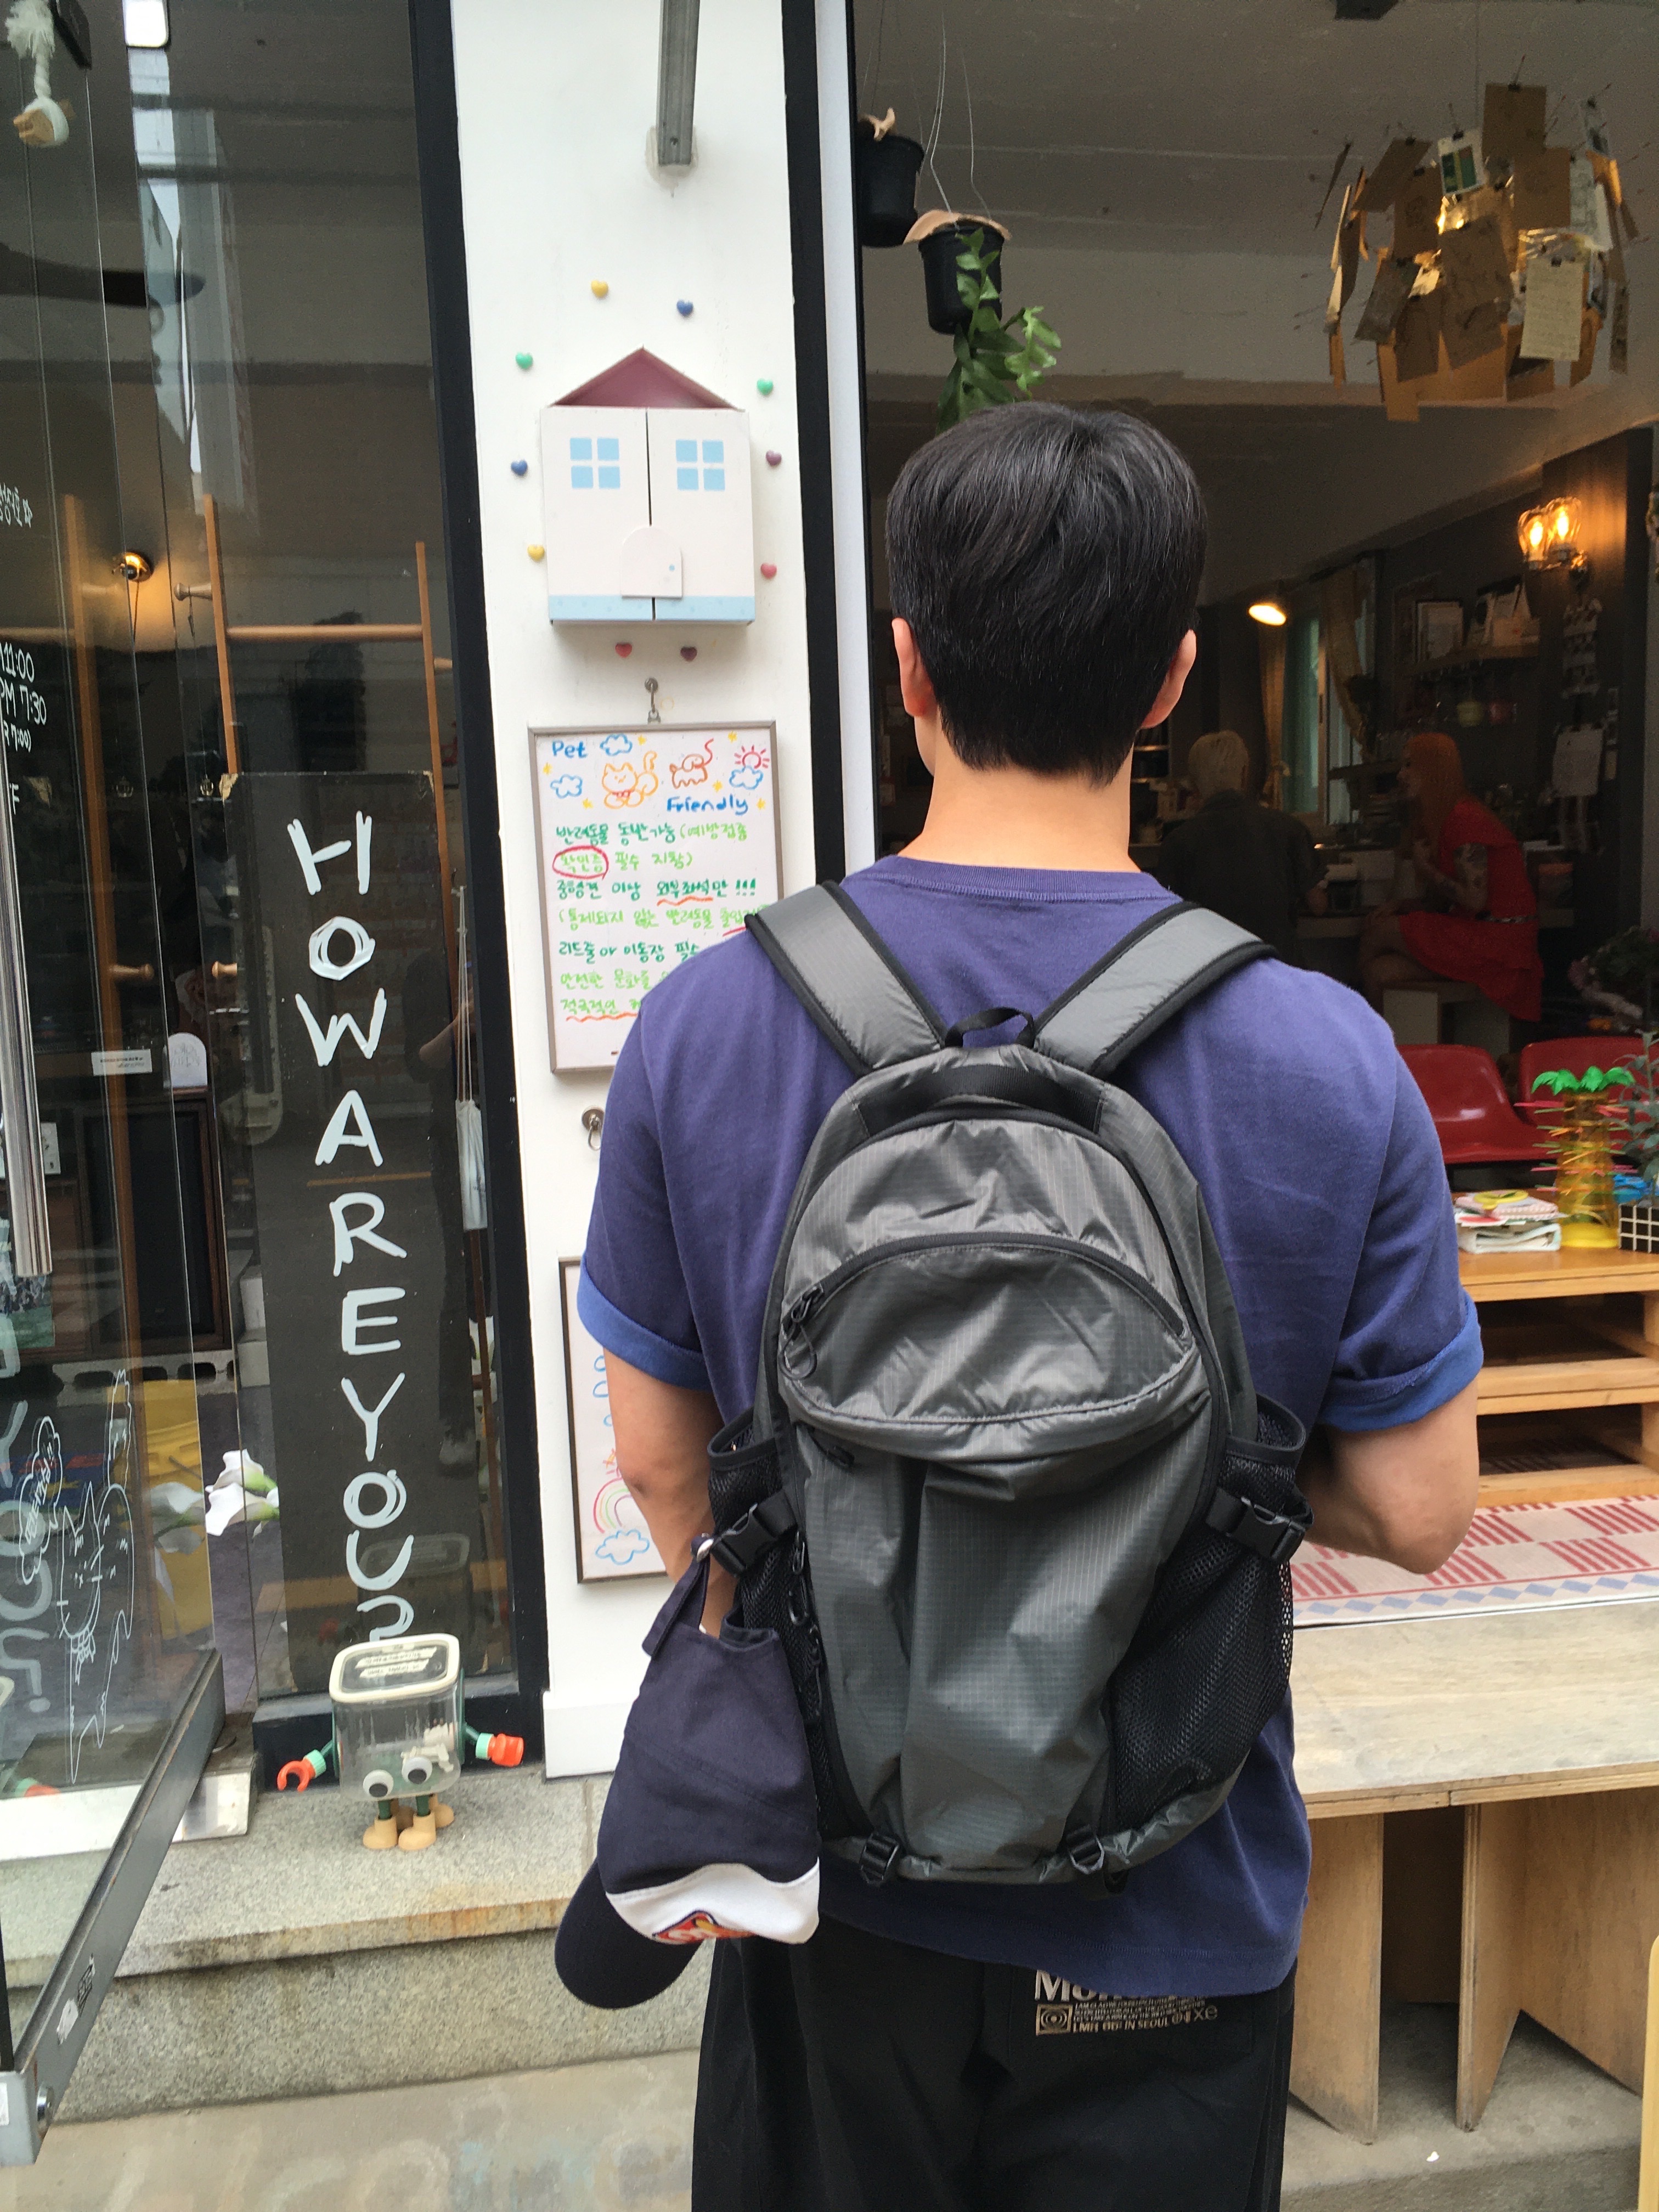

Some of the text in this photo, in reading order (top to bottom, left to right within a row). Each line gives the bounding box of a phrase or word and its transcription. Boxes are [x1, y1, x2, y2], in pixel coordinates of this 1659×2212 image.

[20, 684, 47, 725] 7:30
[552, 740, 588, 759] Pet
[667, 794, 749, 815] Friendly
[556, 823, 609, 846] 반려동물
[614, 851, 639, 871] 필수
[557, 879, 602, 900] 중형견
[611, 881, 641, 901] 이상
[633, 908, 659, 929] 않는
[665, 908, 714, 929] 반려동물
[558, 941, 596, 964] 리드줄
[623, 941, 665, 963] 이동장
[560, 998, 619, 1014] 적극적인
